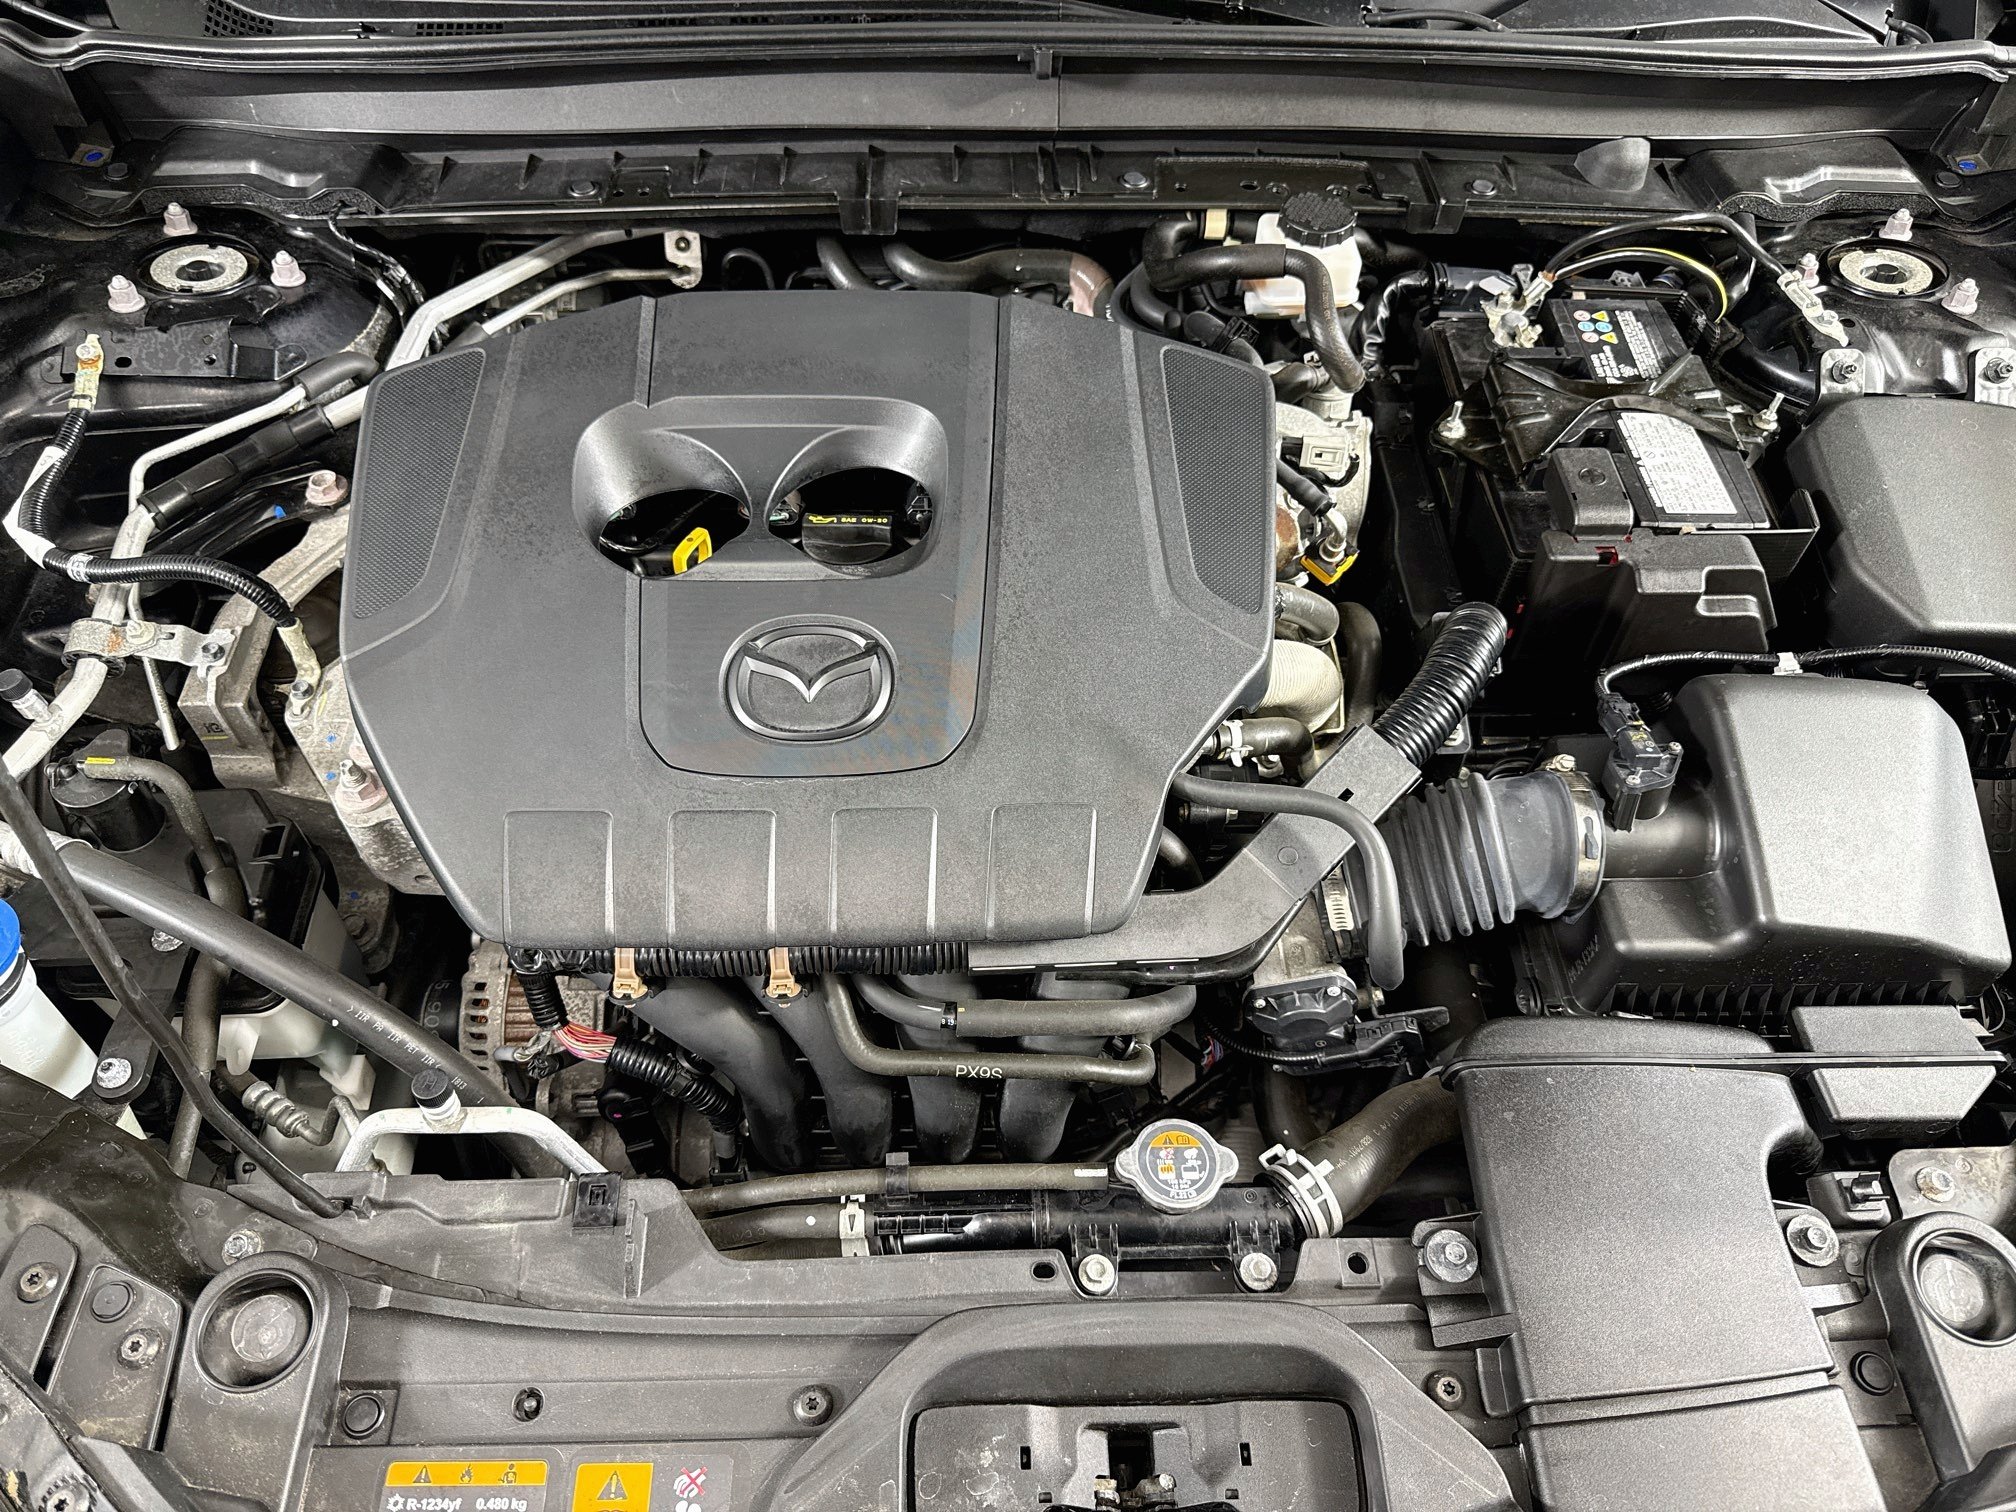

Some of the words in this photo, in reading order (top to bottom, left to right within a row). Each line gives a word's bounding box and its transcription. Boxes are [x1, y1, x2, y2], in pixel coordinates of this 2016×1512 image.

[404, 1042, 419, 1054] PET
[451, 1075, 468, 1090] 1813
[406, 1497, 462, 1512] R-1234yf
[475, 1497, 509, 1510] 0.480
[511, 1497, 528, 1512] kg
